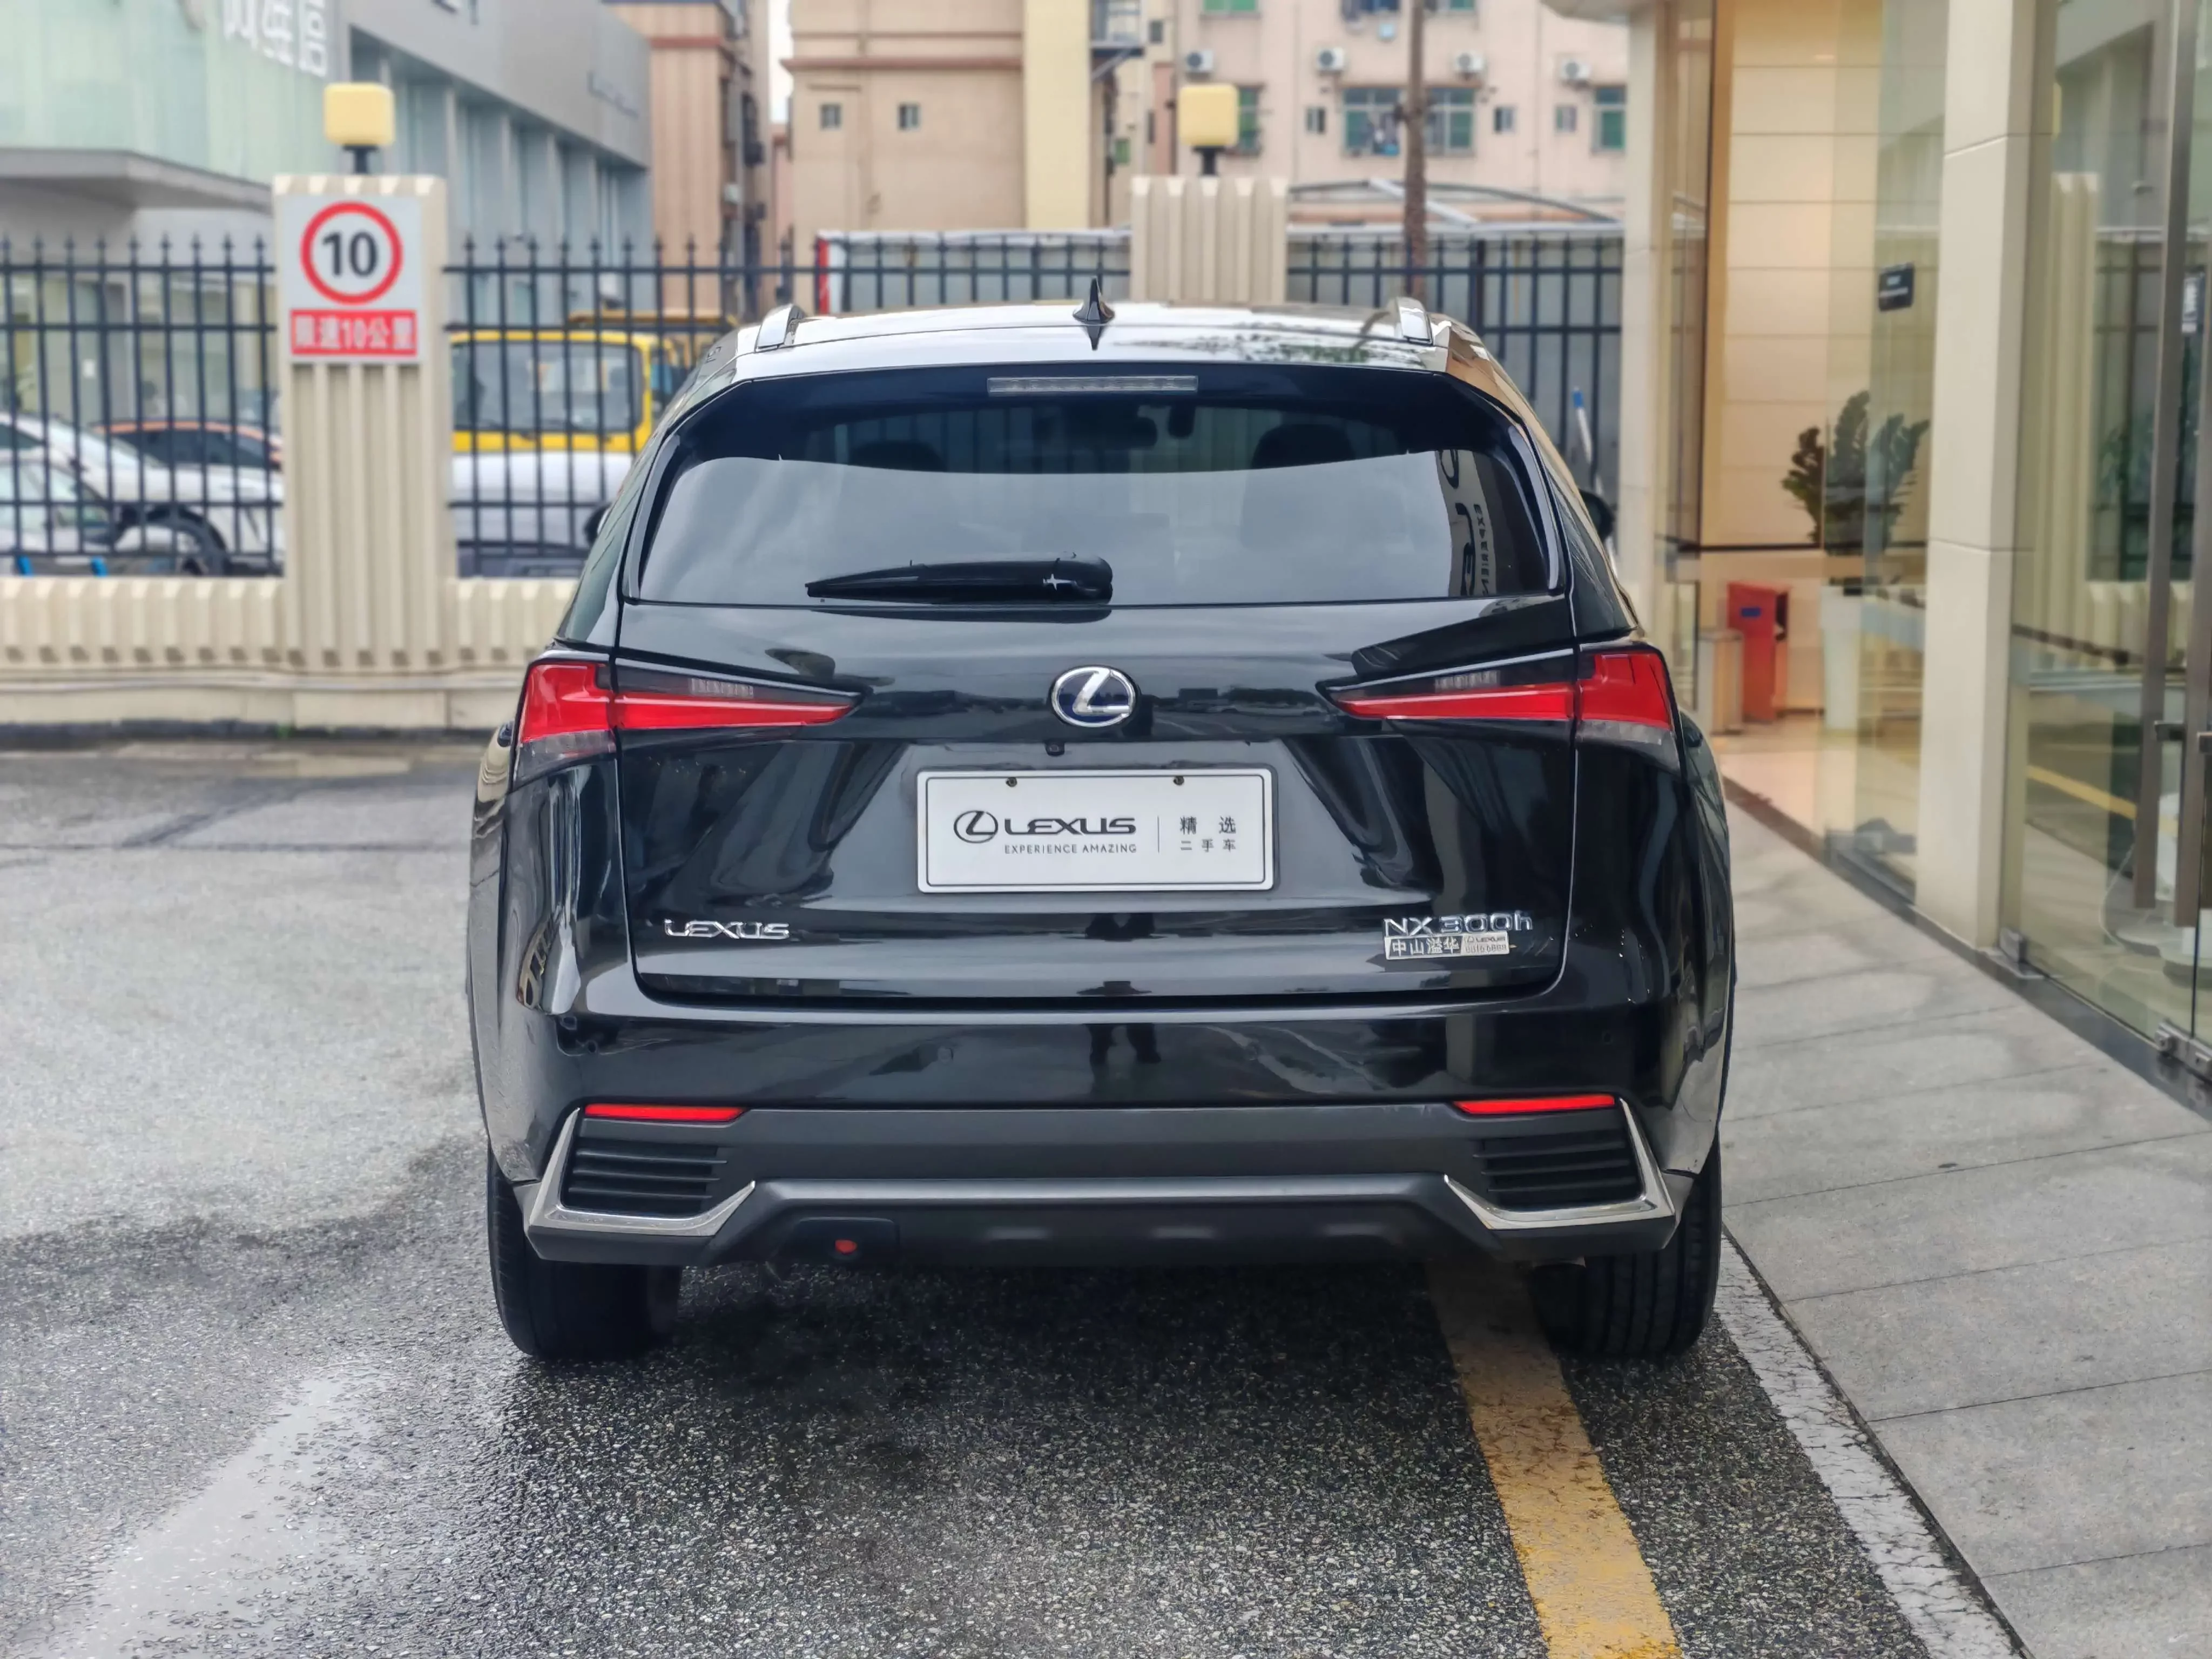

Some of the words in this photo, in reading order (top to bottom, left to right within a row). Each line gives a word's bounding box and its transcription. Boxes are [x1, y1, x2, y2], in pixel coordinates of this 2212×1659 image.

[323, 231, 379, 276] 10
[1004, 818, 1136, 835] LEXUS
[1004, 844, 1077, 854] EXPERIENCE
[1082, 844, 1136, 853] AMAZING
[664, 919, 790, 939] LEXUS
[1384, 917, 1434, 938] NX
[1438, 910, 1533, 933] 300h
